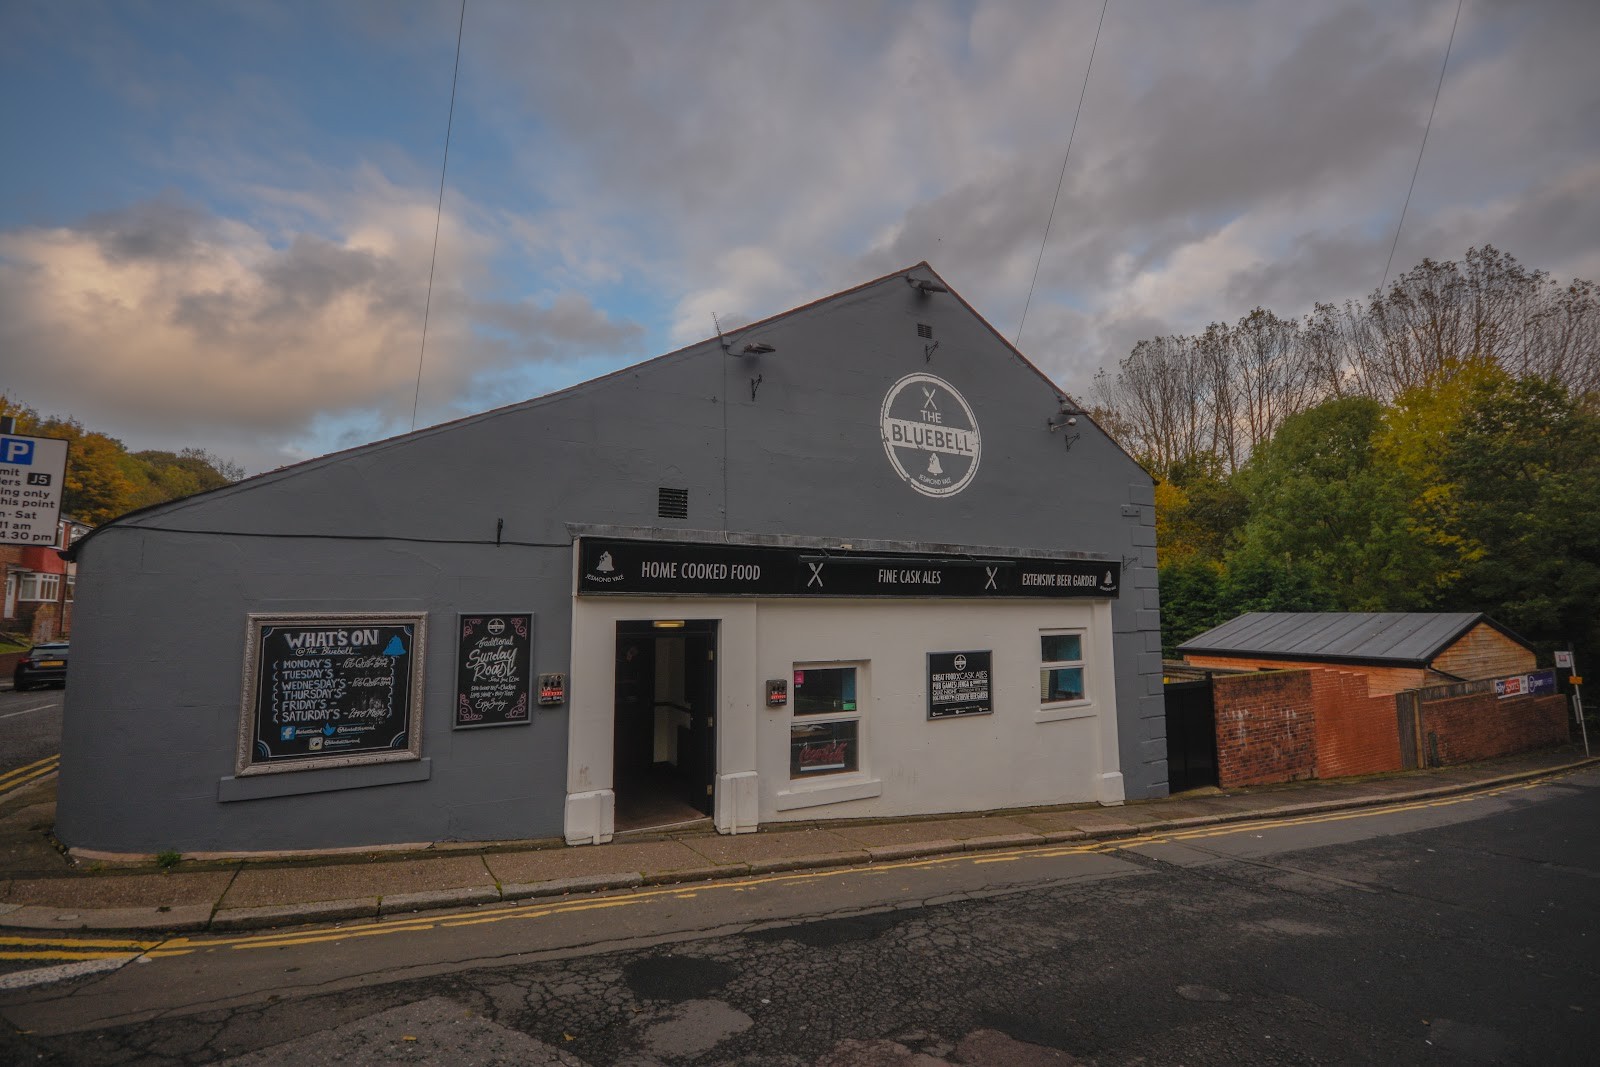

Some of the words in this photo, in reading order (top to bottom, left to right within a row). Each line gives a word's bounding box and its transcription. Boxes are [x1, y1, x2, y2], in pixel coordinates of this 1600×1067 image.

[920, 409, 942, 424] THE
[891, 423, 973, 453] BLUEBELL
[6, 441, 29, 462] P
[0, 477, 21, 486] ers
[30, 474, 48, 486] J5
[23, 490, 50, 500] only
[22, 500, 55, 509] point
[15, 510, 37, 520] Sat
[0, 531, 29, 540] 4.30
[32, 534, 52, 542] pm
[641, 561, 678, 579] HOME
[681, 562, 728, 580] COOKED
[730, 564, 761, 581] FOOD
[878, 568, 898, 584] FINE
[900, 569, 921, 584] CASK
[922, 570, 942, 585] ALES
[585, 573, 612, 583] JESMOND
[1022, 573, 1056, 586] EXTENSIVE
[1056, 573, 1072, 587] BEER
[1072, 574, 1098, 588] GARDEN
[284, 628, 348, 649] WHAT'S
[351, 629, 380, 646] ON
[320, 646, 354, 656] Bluebell
[466, 646, 518, 669] Sunday
[282, 658, 332, 669] MONDAY'S
[282, 668, 334, 680] TUESDAY'S
[473, 660, 517, 682] Roast
[976, 671, 987, 679] ALES
[281, 678, 347, 691] WEDNESDAY'S
[281, 698, 328, 712] FRIDAY'S
[281, 708, 341, 723] SATURDAY'S
